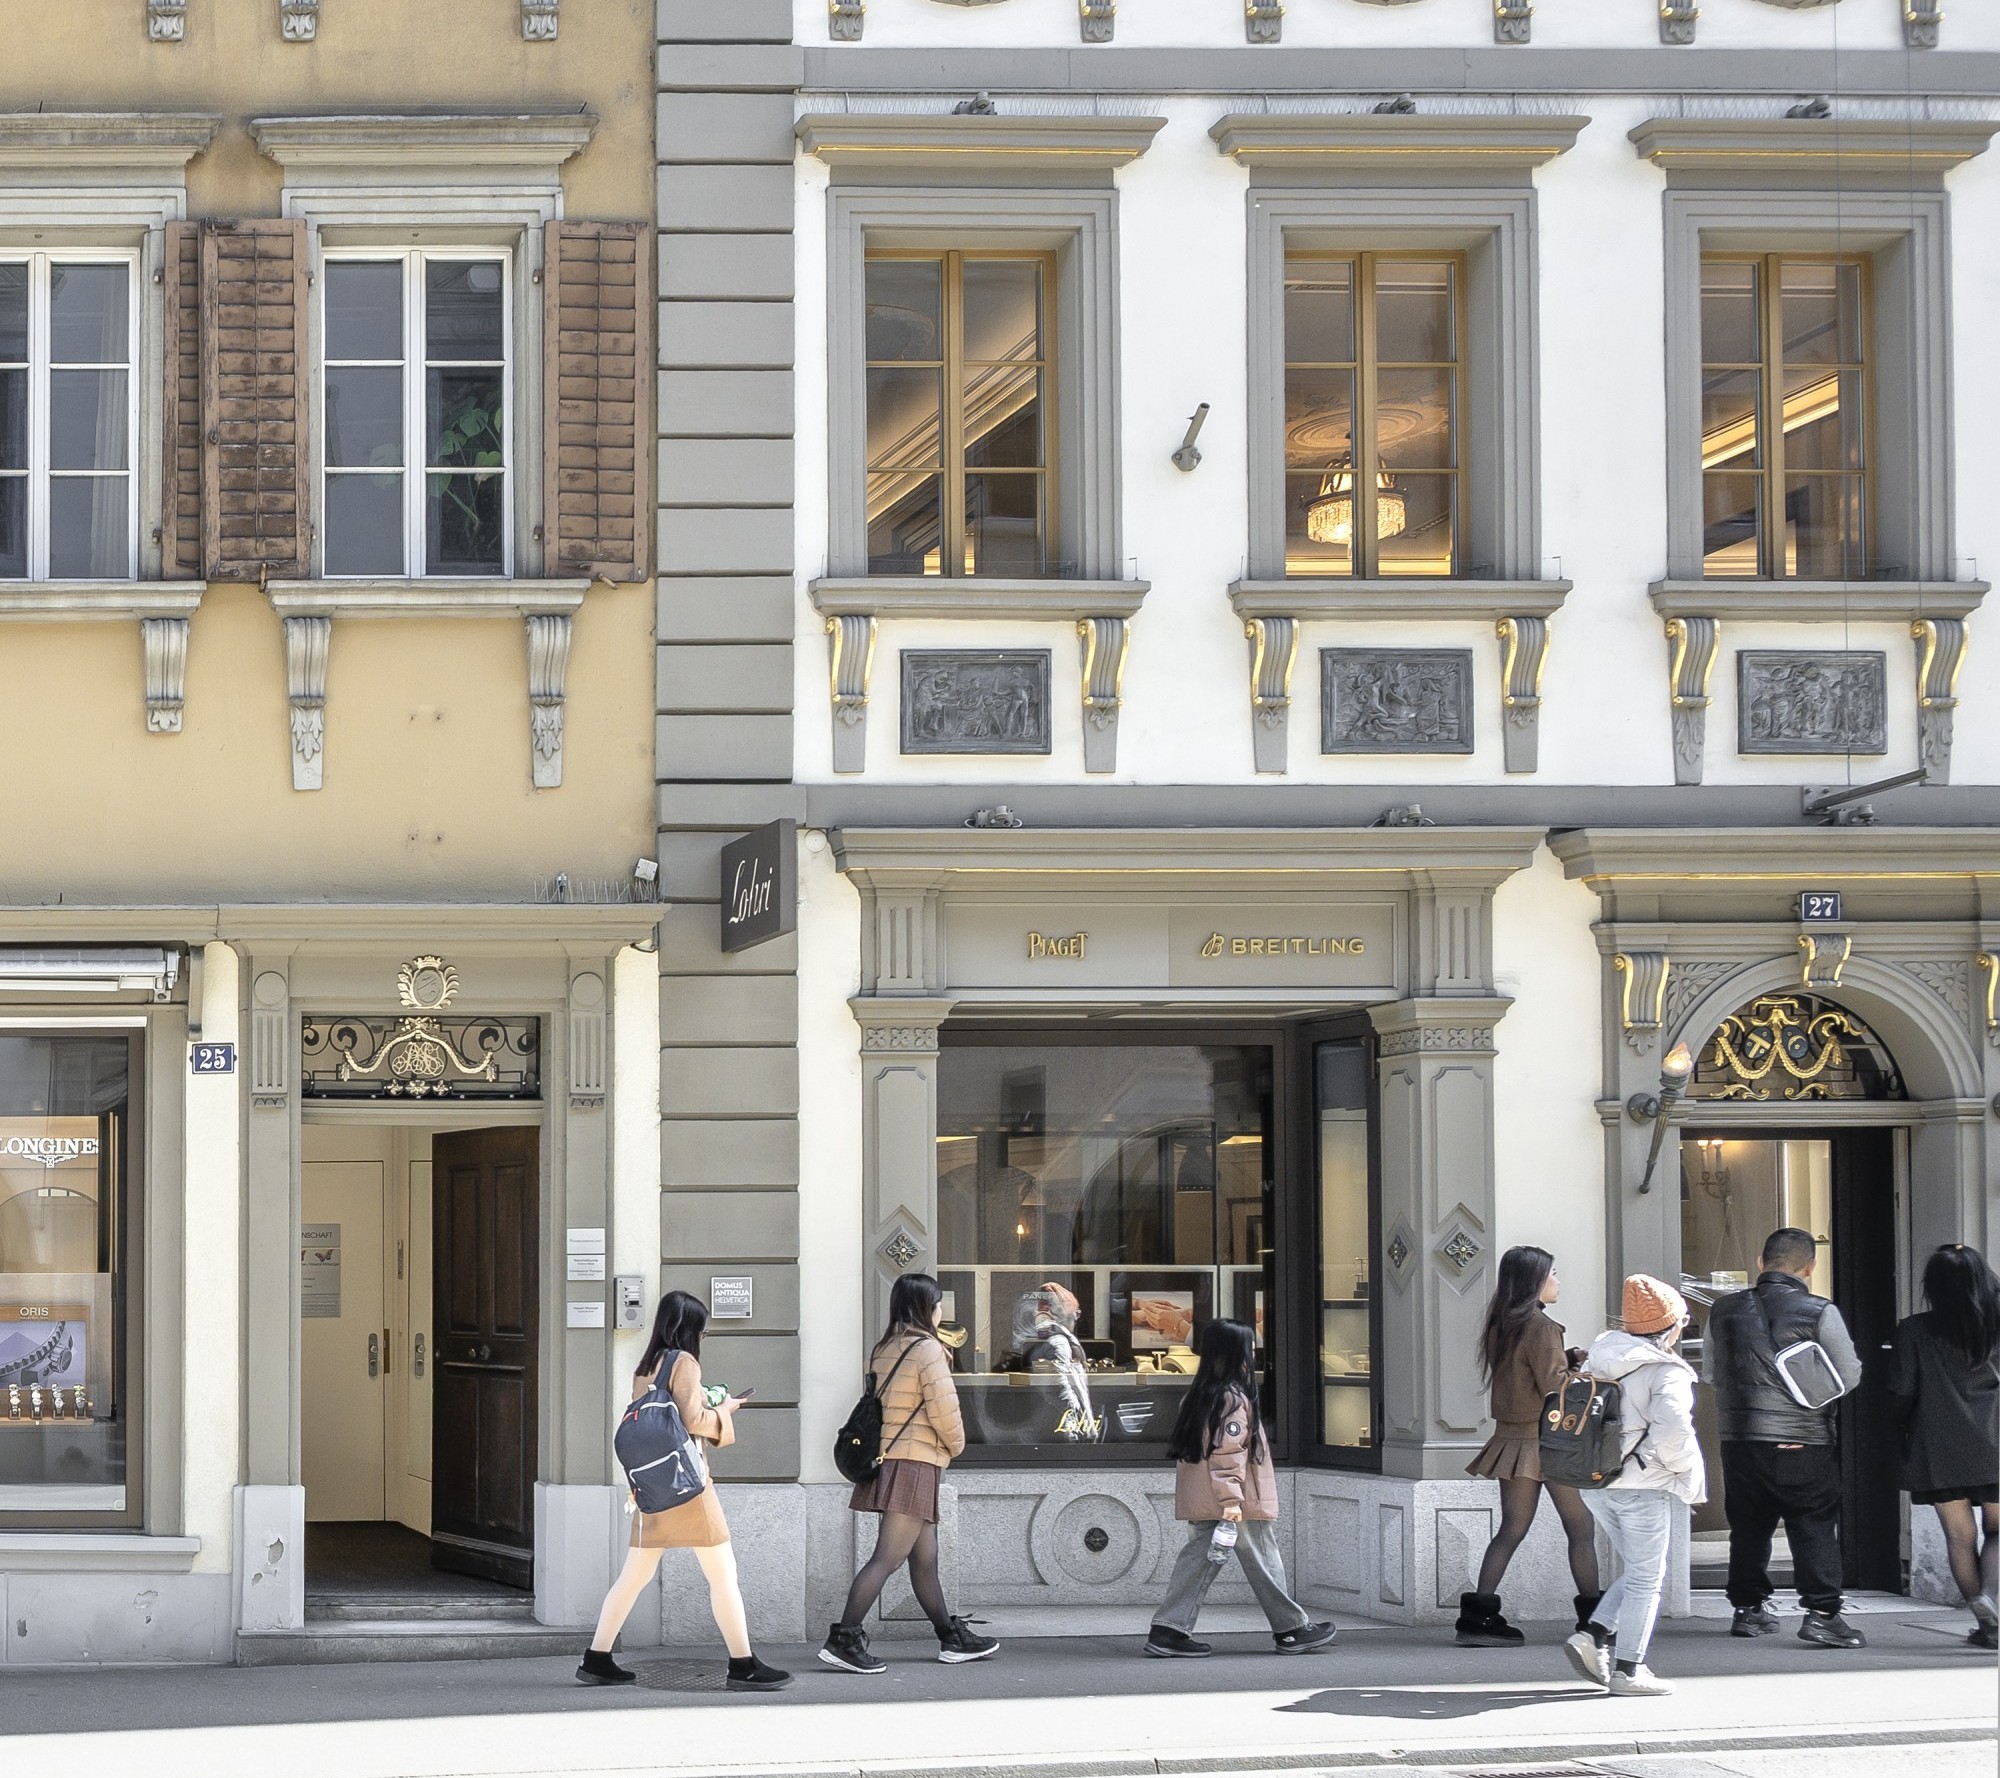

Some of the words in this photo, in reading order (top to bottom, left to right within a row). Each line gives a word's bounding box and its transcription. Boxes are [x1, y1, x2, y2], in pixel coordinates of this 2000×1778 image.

[728, 857, 773, 924] Lohri
[1809, 896, 1834, 917] 27
[1028, 932, 1089, 958] PIAGET
[1232, 938, 1365, 954] BREITLING
[200, 1048, 226, 1069] 25
[0, 1137, 99, 1154] ONGINE
[714, 1289, 750, 1297] ANTIQUA
[714, 1296, 750, 1304] HELVETICA
[20, 1307, 48, 1316] ORIS
